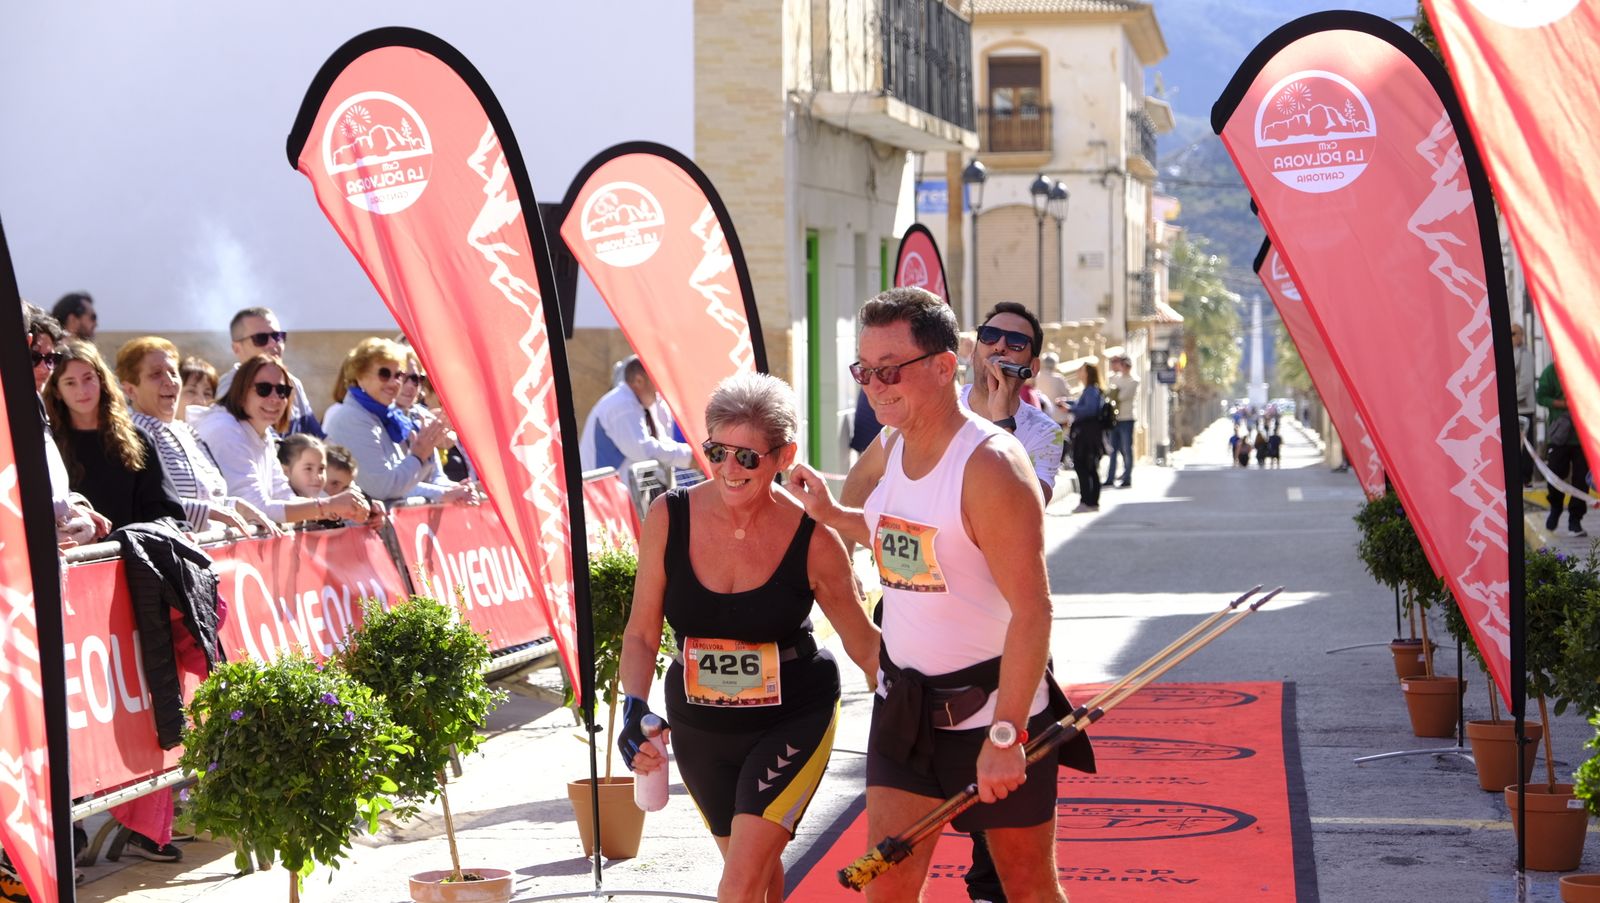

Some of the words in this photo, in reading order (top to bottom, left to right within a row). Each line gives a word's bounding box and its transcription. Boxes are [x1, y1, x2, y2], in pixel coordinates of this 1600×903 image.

[882, 533, 919, 562] 427
[698, 653, 760, 676] 426
[1125, 868, 1176, 876] de
